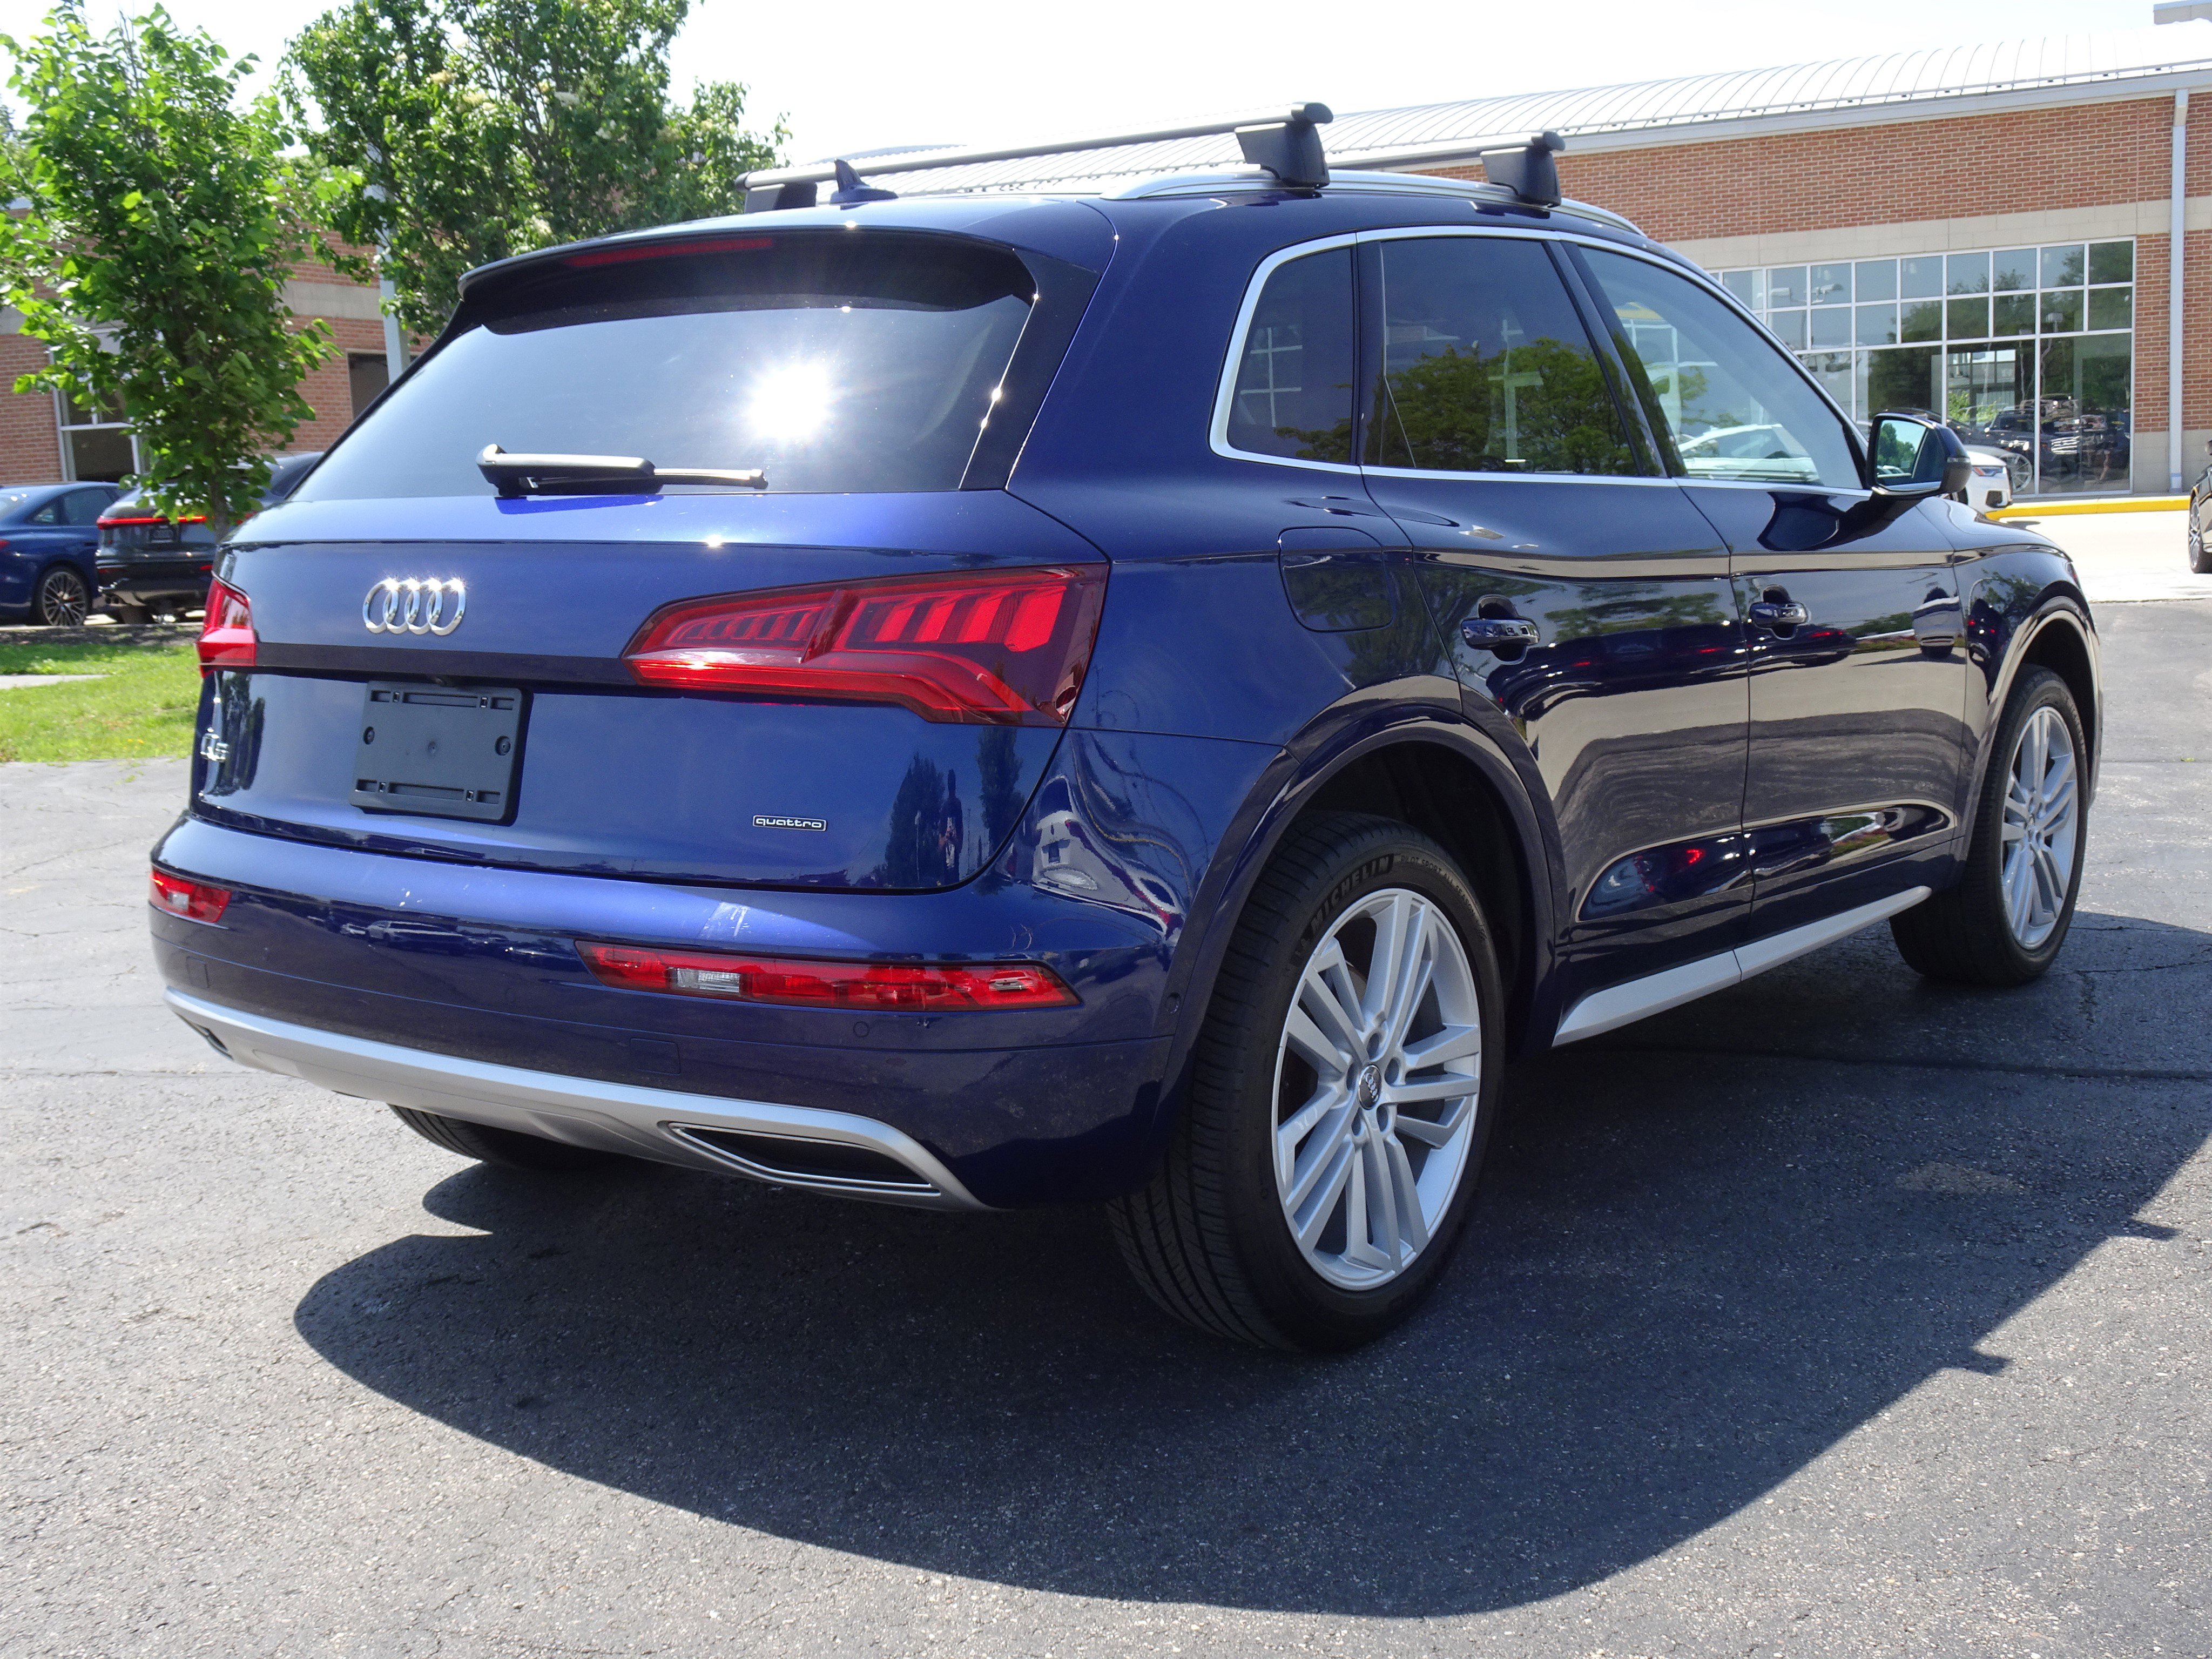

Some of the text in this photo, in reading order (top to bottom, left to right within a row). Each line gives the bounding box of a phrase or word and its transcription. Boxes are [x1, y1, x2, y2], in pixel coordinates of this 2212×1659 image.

[200, 733, 229, 762] Q5
[756, 818, 822, 828] quattro
[1421, 859, 1442, 873] SPORT
[1311, 855, 1390, 934] MICHELIN
